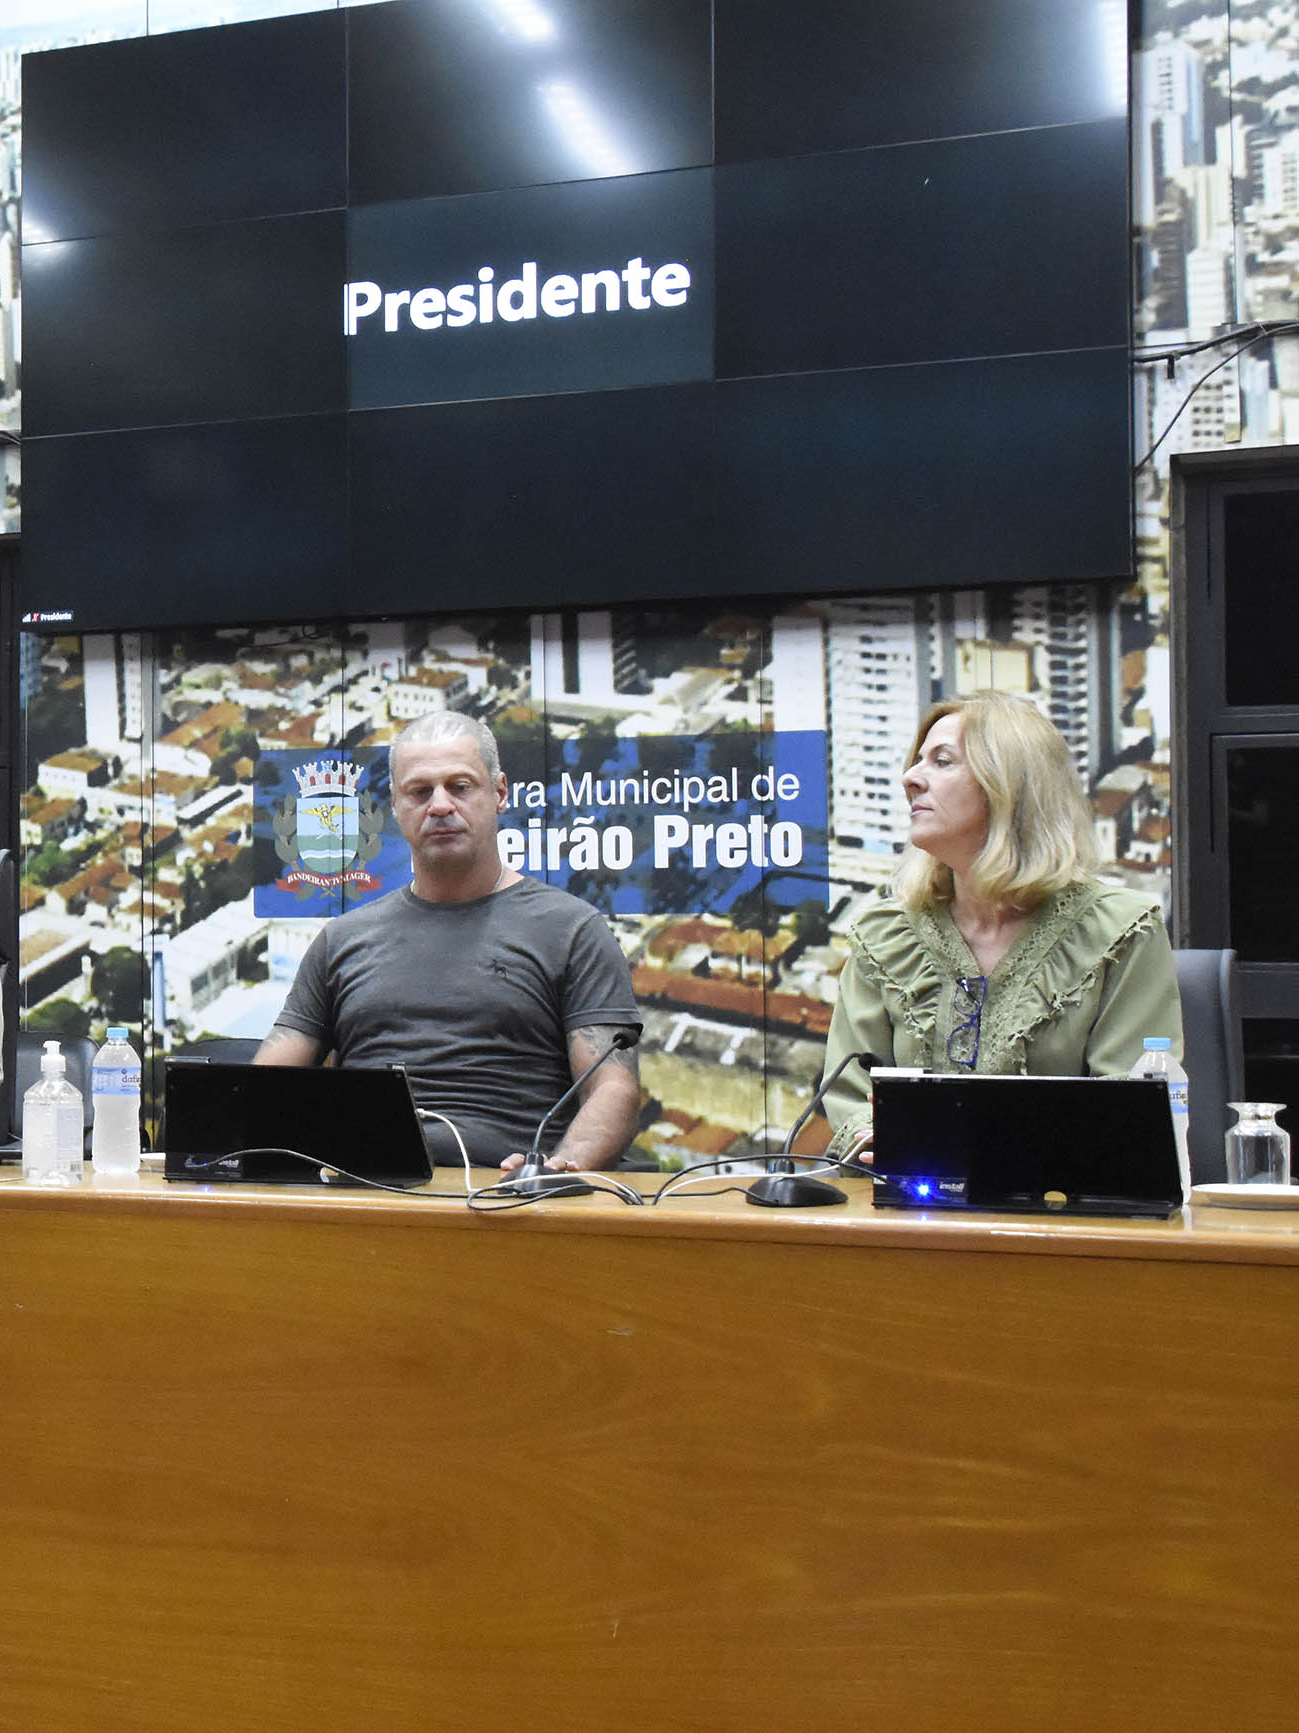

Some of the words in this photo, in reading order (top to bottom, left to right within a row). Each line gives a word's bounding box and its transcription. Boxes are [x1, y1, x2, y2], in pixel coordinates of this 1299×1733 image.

[343, 257, 691, 335] Presidente
[40, 612, 72, 621] Presidente
[561, 767, 739, 812] Municipal
[751, 766, 800, 801] de
[497, 815, 633, 872] eirão
[653, 814, 803, 869] Preto
